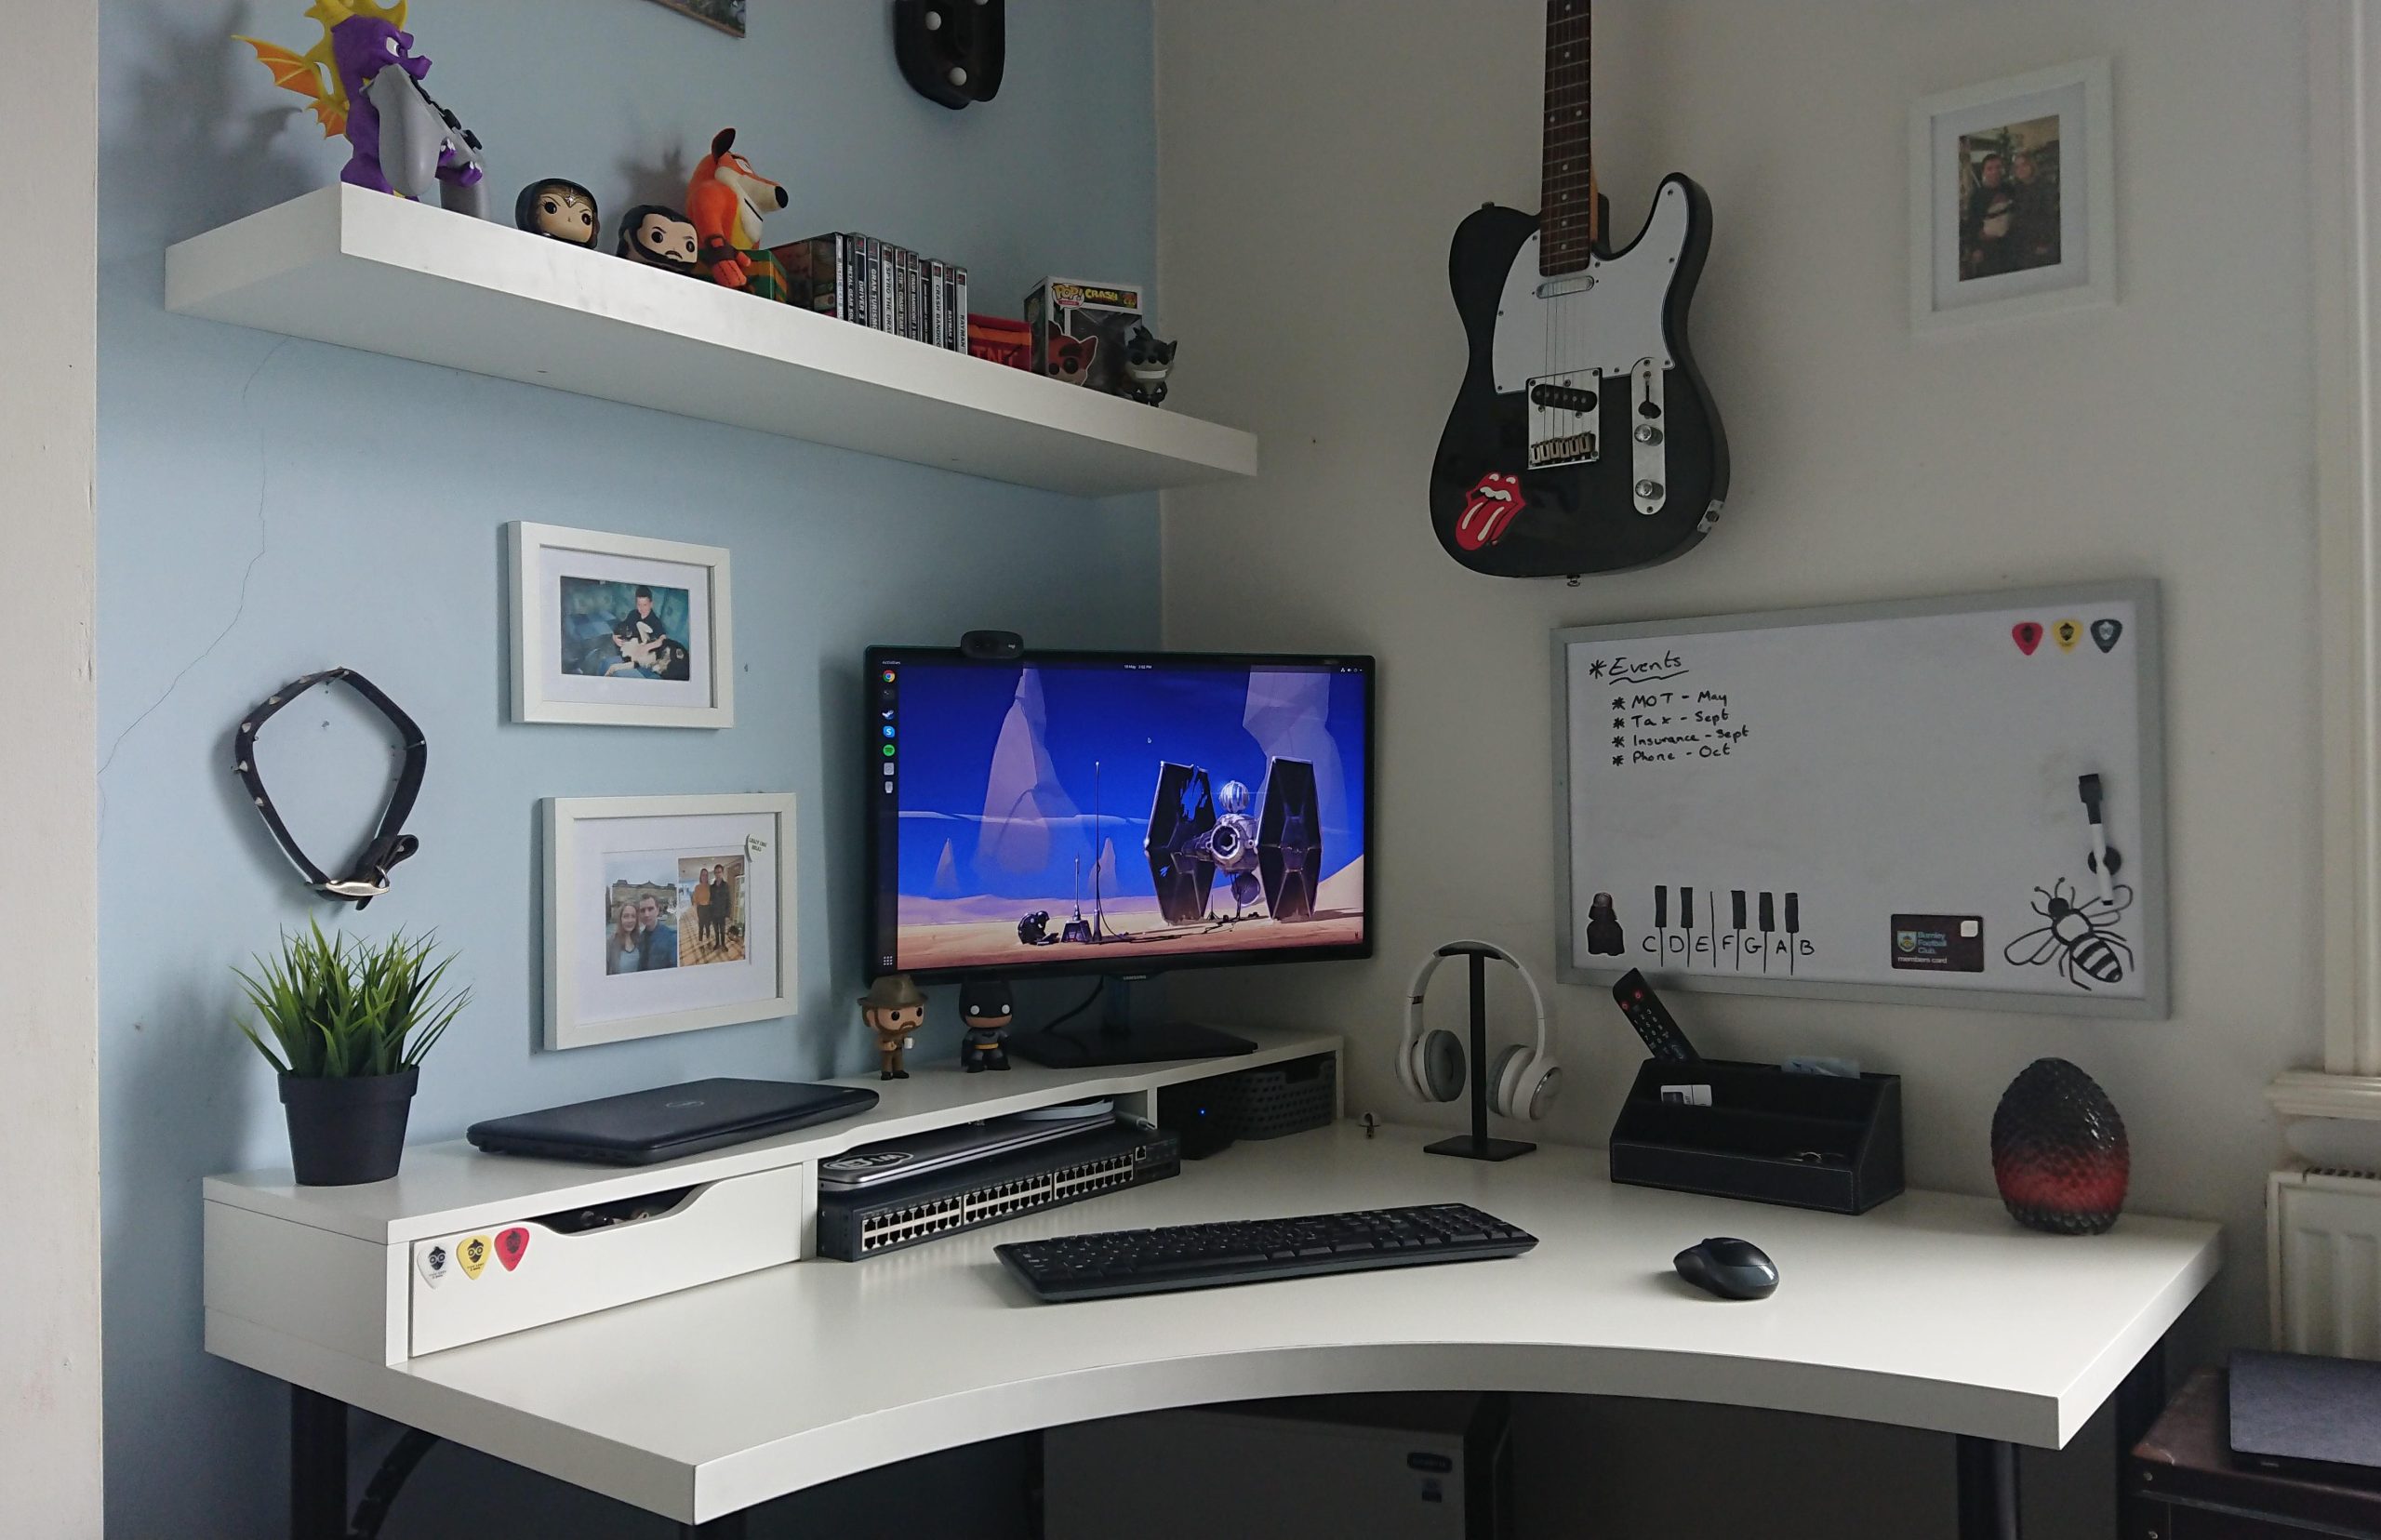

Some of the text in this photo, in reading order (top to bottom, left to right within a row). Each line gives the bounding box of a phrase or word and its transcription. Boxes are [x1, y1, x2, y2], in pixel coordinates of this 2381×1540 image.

[1052, 285, 1084, 300] POP!
[1084, 288, 1118, 300] CRASH
[1609, 650, 1683, 676] Events
[1631, 693, 1673, 709] MOT
[1697, 690, 1727, 707] May
[1631, 715, 1671, 727] Tax
[1695, 709, 1729, 726] Sept
[1633, 734, 1700, 747] Insurance
[1716, 724, 1749, 743] Sept
[1633, 750, 1676, 763] Phone
[1698, 742, 1731, 757] Oct
[1918, 931, 1946, 939] Burnley
[1642, 935, 1815, 955] C D E F G A B
